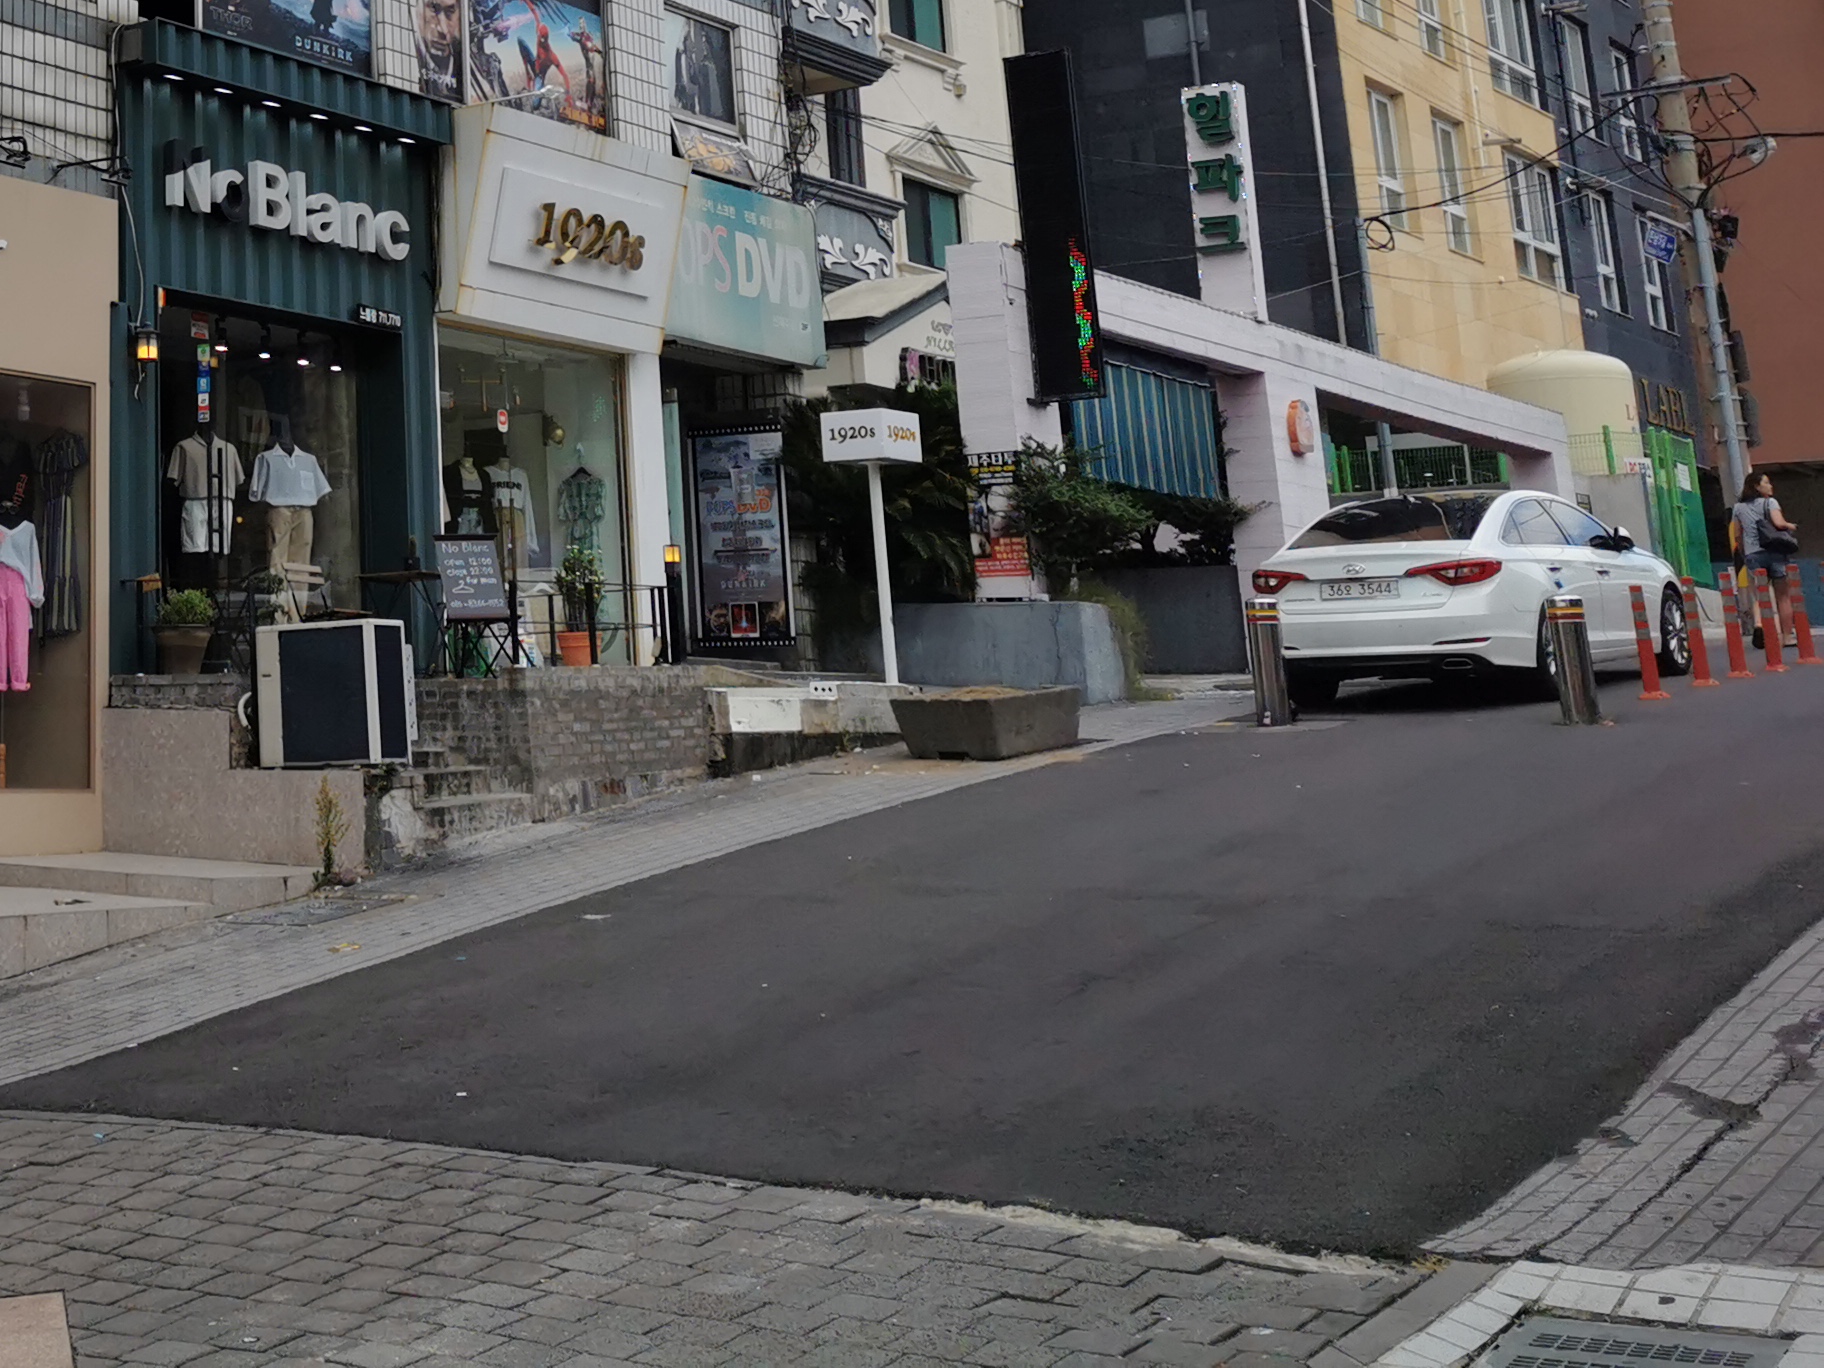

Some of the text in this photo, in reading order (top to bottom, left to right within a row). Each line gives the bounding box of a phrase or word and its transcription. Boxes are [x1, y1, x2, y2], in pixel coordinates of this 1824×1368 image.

[209, 5, 254, 31] THOR
[294, 34, 354, 63] DUNKIRK
[1186, 90, 1247, 256] 힐파크
[530, 201, 646, 272] 1920s
[734, 230, 812, 310] DVD
[828, 425, 876, 444] 1920s
[886, 424, 916, 443] 1920s
[441, 542, 459, 553] No
[1358, 582, 1393, 596] 3544
